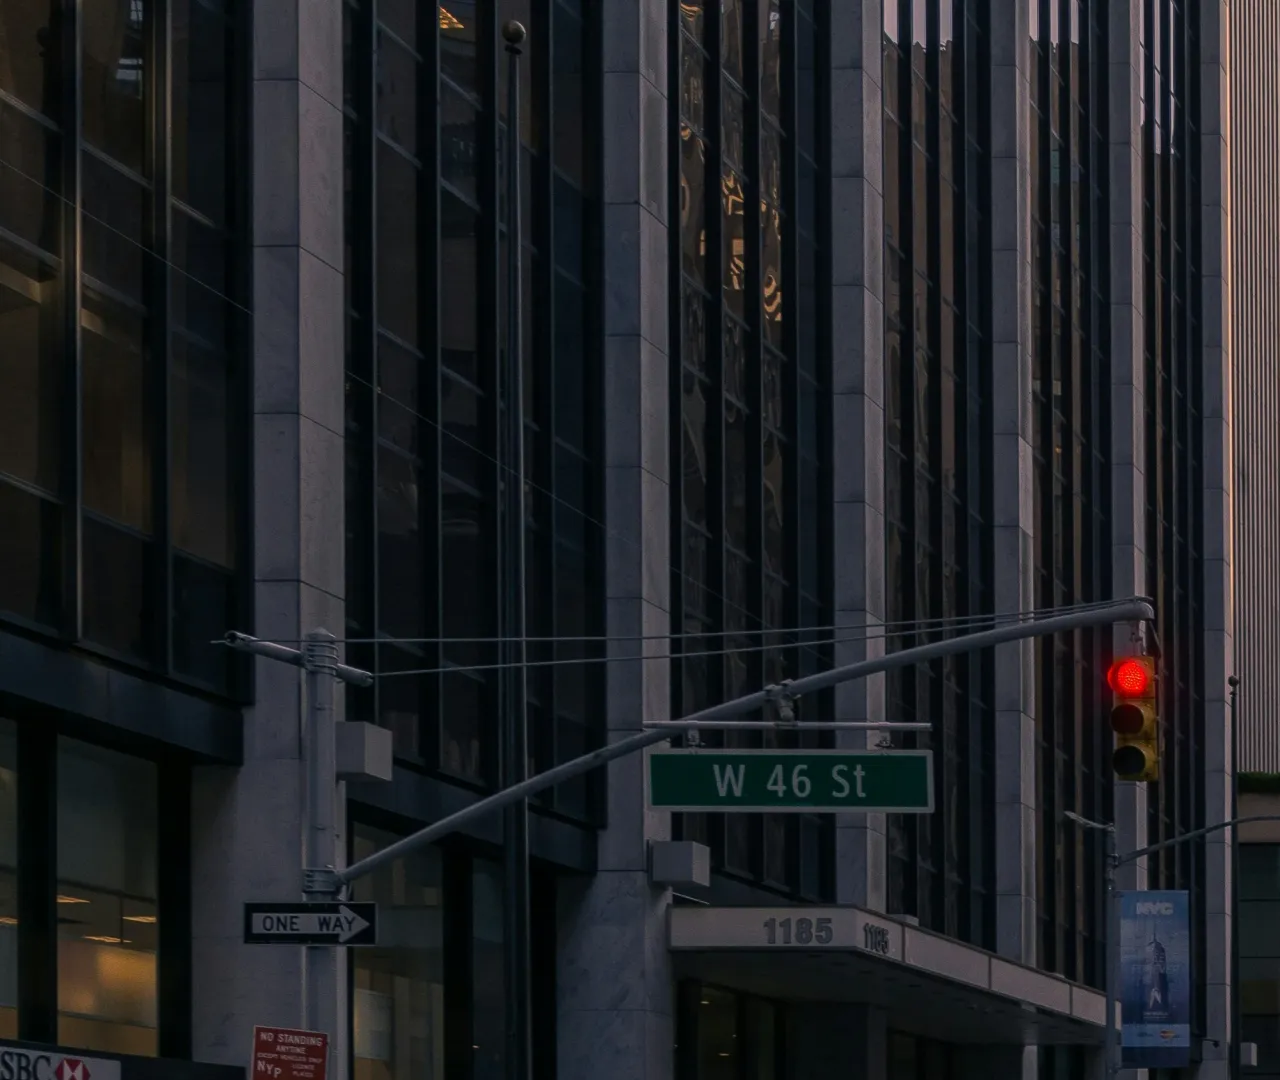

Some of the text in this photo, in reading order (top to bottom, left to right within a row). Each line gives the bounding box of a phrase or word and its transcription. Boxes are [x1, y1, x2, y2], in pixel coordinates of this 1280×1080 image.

[712, 765, 867, 799] W 46 St
[1136, 902, 1174, 915] NYC
[262, 914, 356, 933] ONE WAY
[763, 918, 833, 945] 1185
[260, 1031, 323, 1047] NO STANDING
